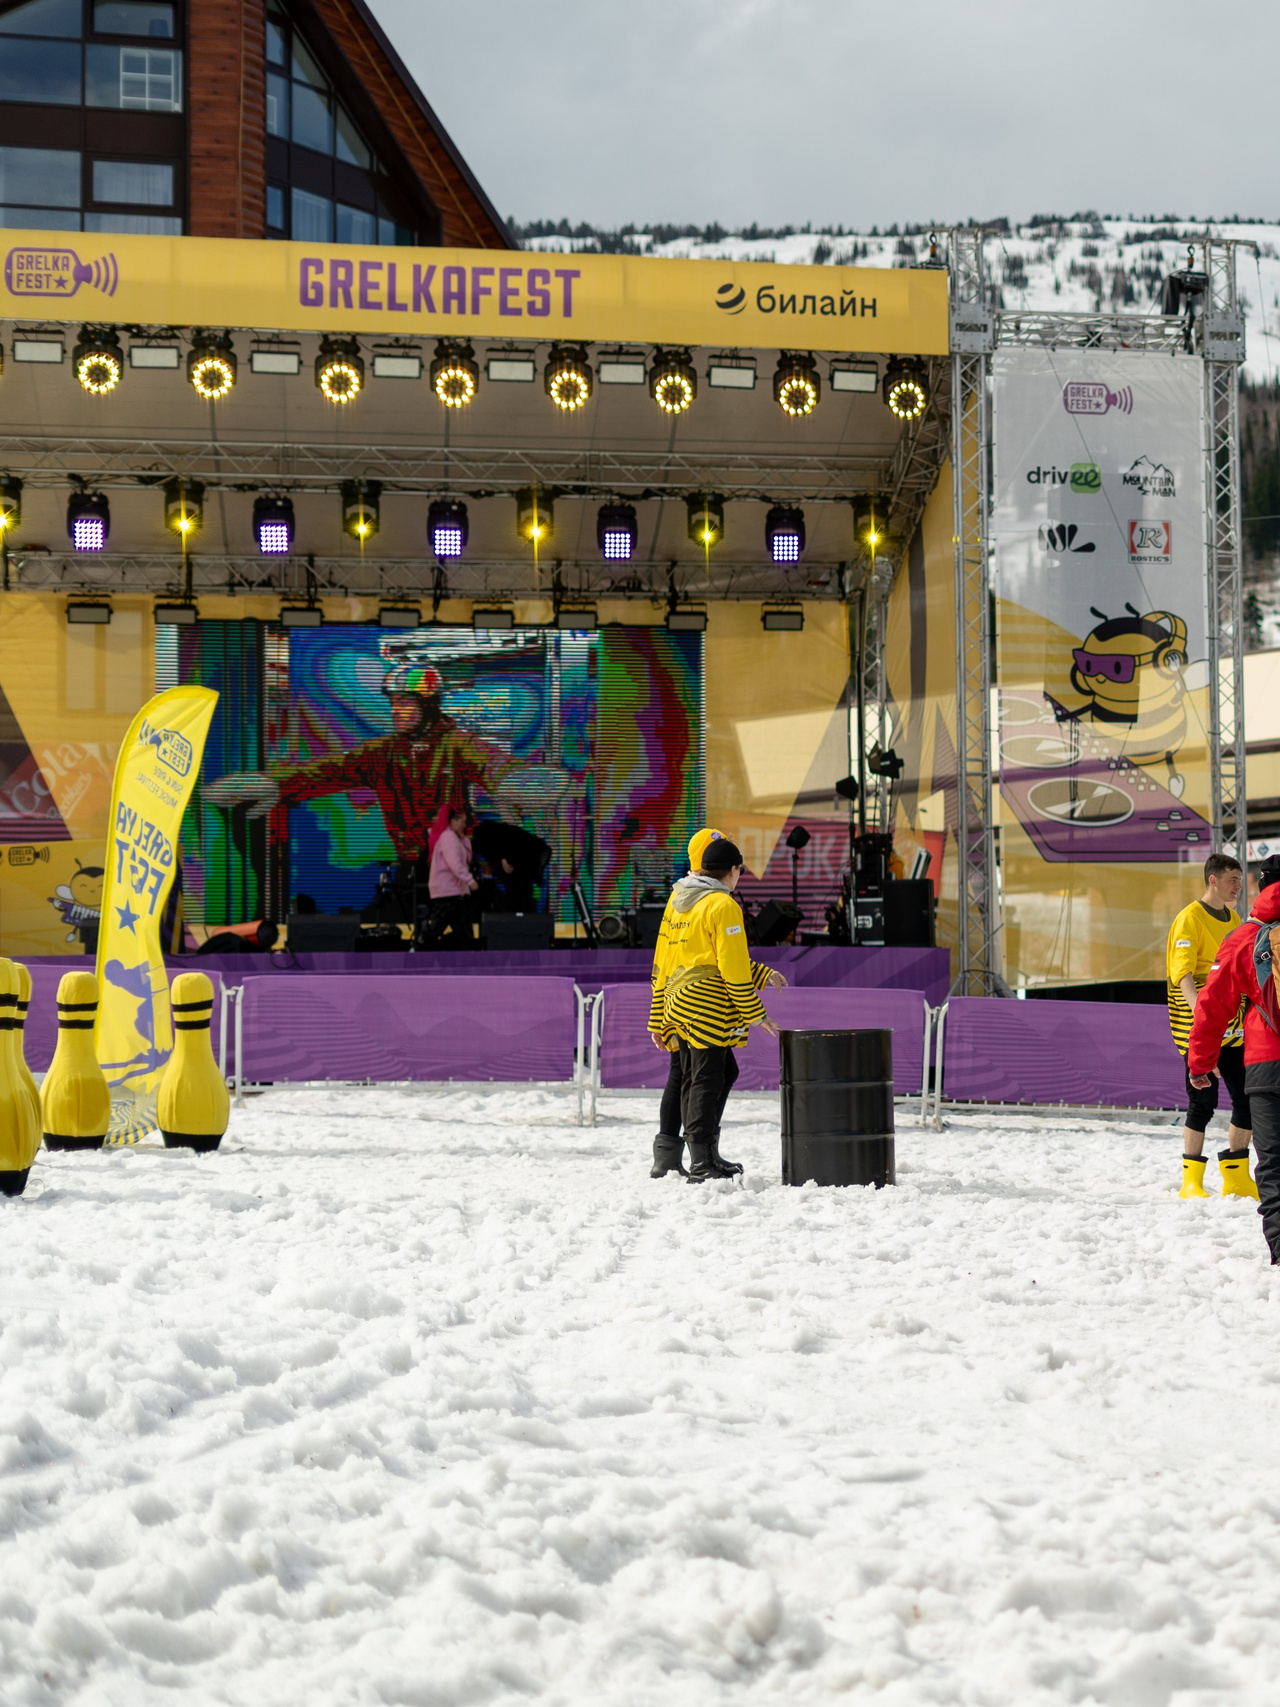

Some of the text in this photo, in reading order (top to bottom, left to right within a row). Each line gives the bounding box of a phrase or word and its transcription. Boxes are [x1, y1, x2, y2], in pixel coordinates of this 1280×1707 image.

[16, 254, 70, 272] GRELKA
[16, 272, 52, 289] FEST
[300, 257, 581, 318] GRELKAFEST
[756, 285, 877, 318] билайн
[1070, 386, 1104, 398] GRELKA
[1070, 399, 1093, 410] FEST
[1027, 466, 1102, 488] drivee
[1152, 487, 1176, 498] MAN
[1130, 555, 1170, 563] ROSTIC'S
